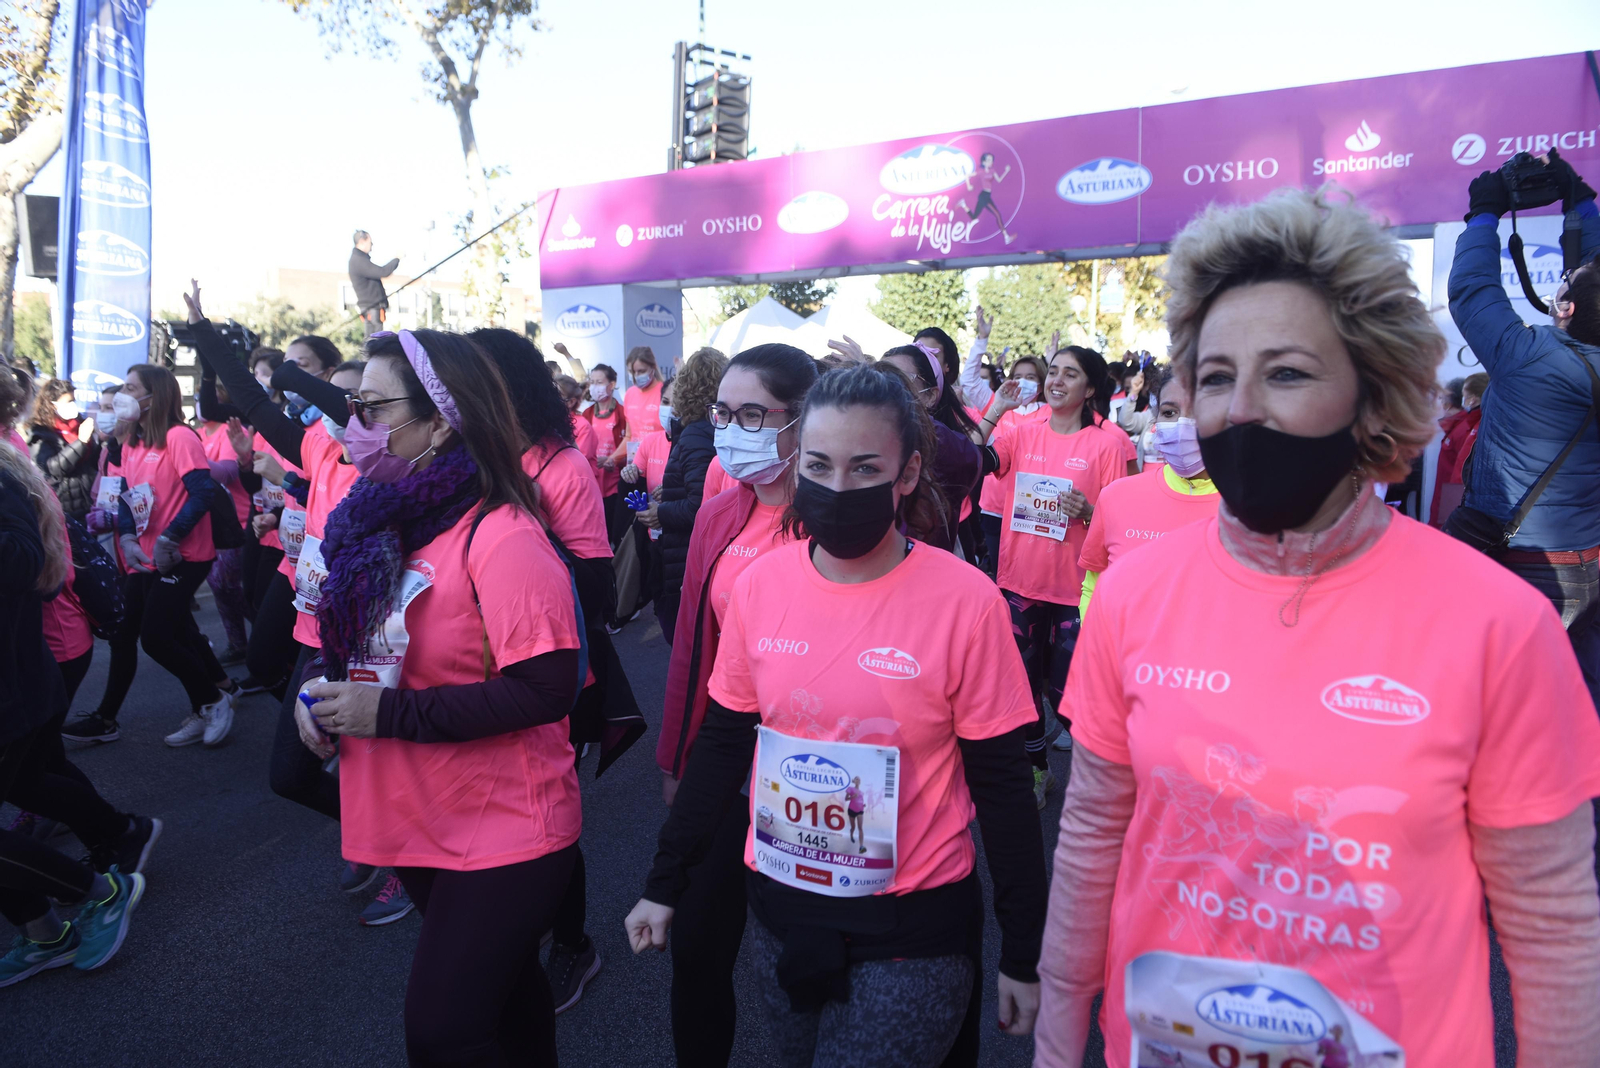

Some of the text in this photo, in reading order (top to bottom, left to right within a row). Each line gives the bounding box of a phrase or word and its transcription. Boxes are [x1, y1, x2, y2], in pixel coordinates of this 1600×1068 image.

[1497, 130, 1597, 156] ZURICH
[892, 165, 967, 184] ASTURIANA
[1183, 157, 1279, 186] OYSHO
[1312, 151, 1414, 176] Santander
[1065, 176, 1143, 195] ASTURIANA
[872, 194, 950, 222] Carrera
[637, 223, 684, 241] ZURICH
[702, 213, 762, 236] OYSHO
[890, 211, 980, 255] de la Mujer
[560, 317, 607, 330] ASTURIANA
[638, 313, 675, 330] ASTURIANA
[1033, 498, 1057, 512] 016
[758, 637, 809, 656] OYSHO
[372, 656, 398, 665] MUJER
[861, 654, 916, 676] ASTURIANA
[1135, 663, 1231, 693] OYSHO
[1329, 688, 1422, 717] ASTURIANA
[784, 763, 844, 786] ASTURIANA
[785, 796, 846, 832] 016
[797, 831, 829, 849] 1445
[1305, 831, 1392, 871] POR
[757, 850, 791, 874] OYSHO
[771, 838, 866, 867] CARRERA DE LA MUJER
[804, 870, 828, 881] Santander
[854, 878, 886, 886] ZURICH
[1252, 863, 1386, 910] TODAS
[1177, 880, 1382, 951] NOSOTRAS
[1206, 998, 1316, 1038] ASTURIANA
